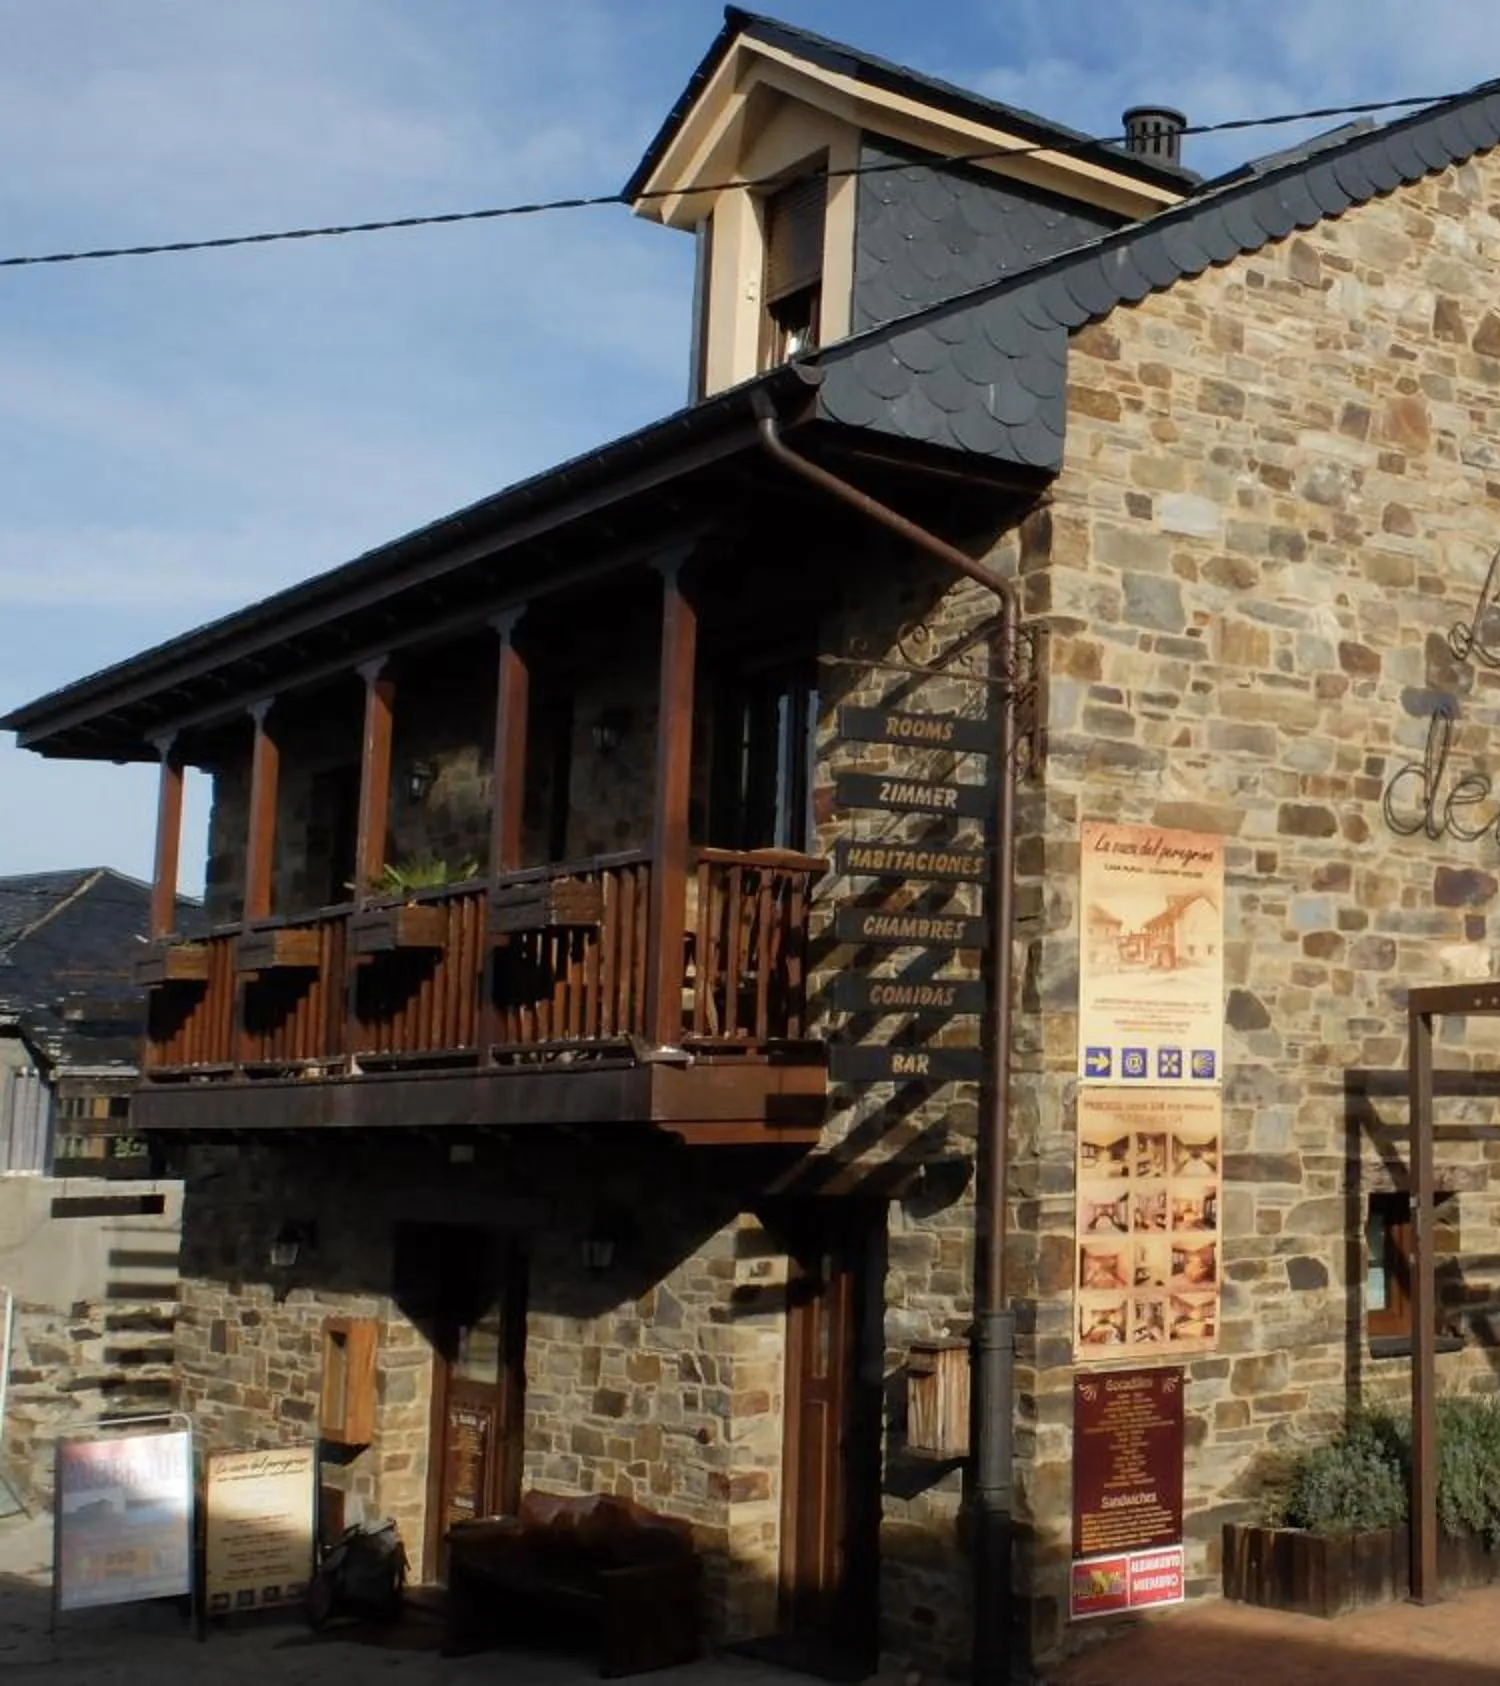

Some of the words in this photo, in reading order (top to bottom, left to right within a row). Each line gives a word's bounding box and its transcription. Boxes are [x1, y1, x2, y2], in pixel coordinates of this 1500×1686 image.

[886, 717, 955, 741] ROOMS
[879, 781, 959, 809] ZIMMER
[847, 848, 985, 875] HABITACIONES
[863, 915, 967, 940] CHAMBRES
[869, 984, 956, 1006] COMIDAS
[892, 1053, 930, 1075] BAR
